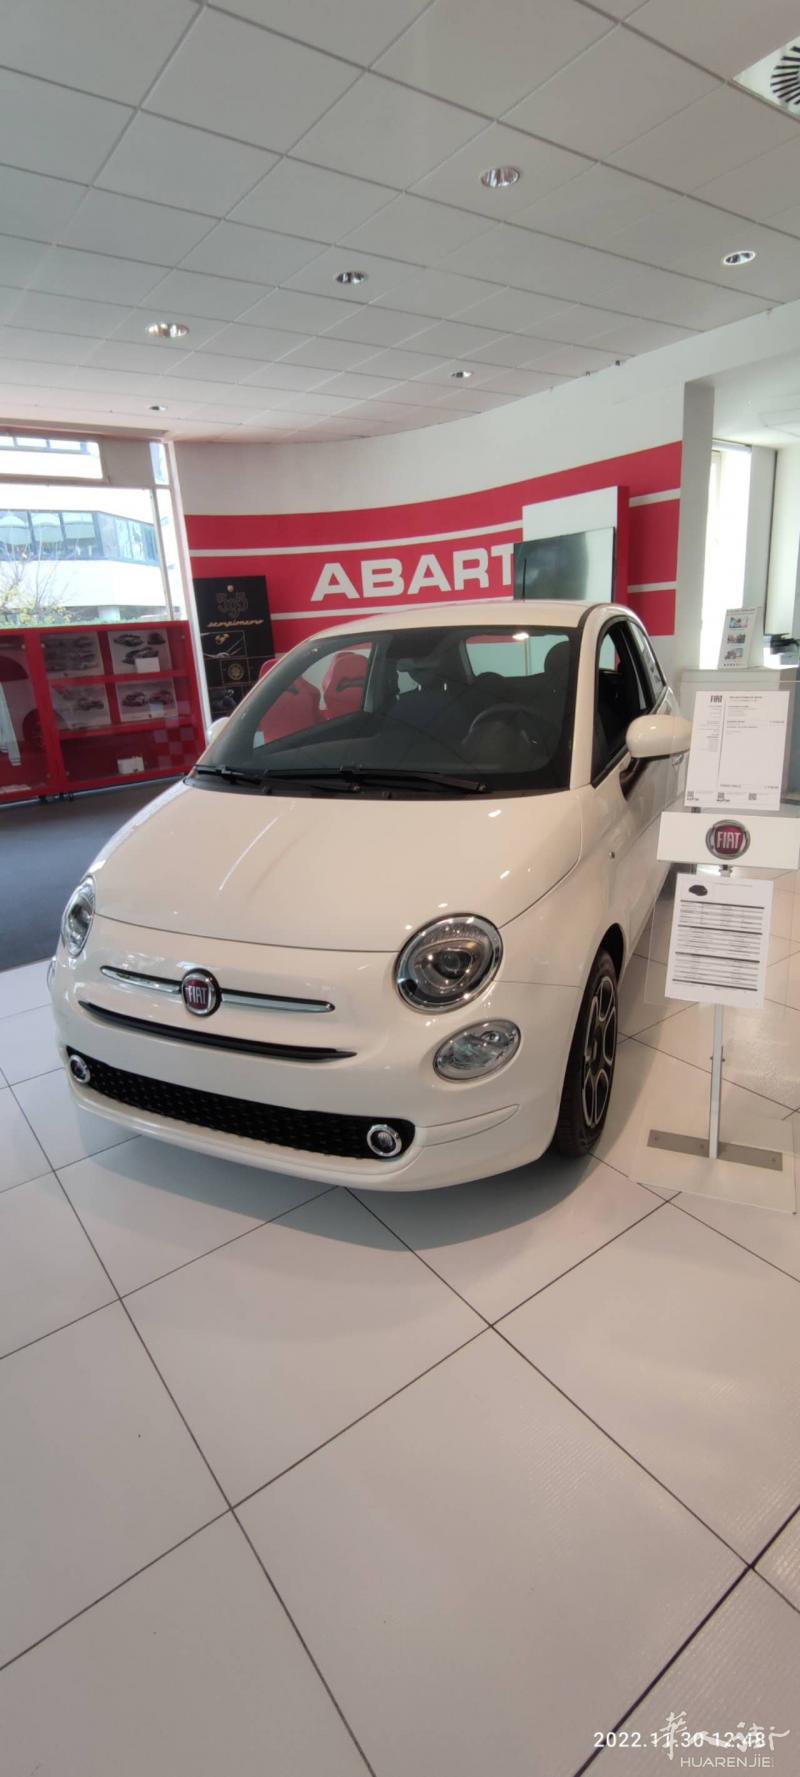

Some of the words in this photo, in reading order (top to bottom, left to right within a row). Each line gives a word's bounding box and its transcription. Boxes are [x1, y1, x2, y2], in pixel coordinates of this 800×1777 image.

[710, 694, 722, 703] FIAT
[716, 831, 742, 849] FIAT
[185, 985, 207, 1005] FIAT
